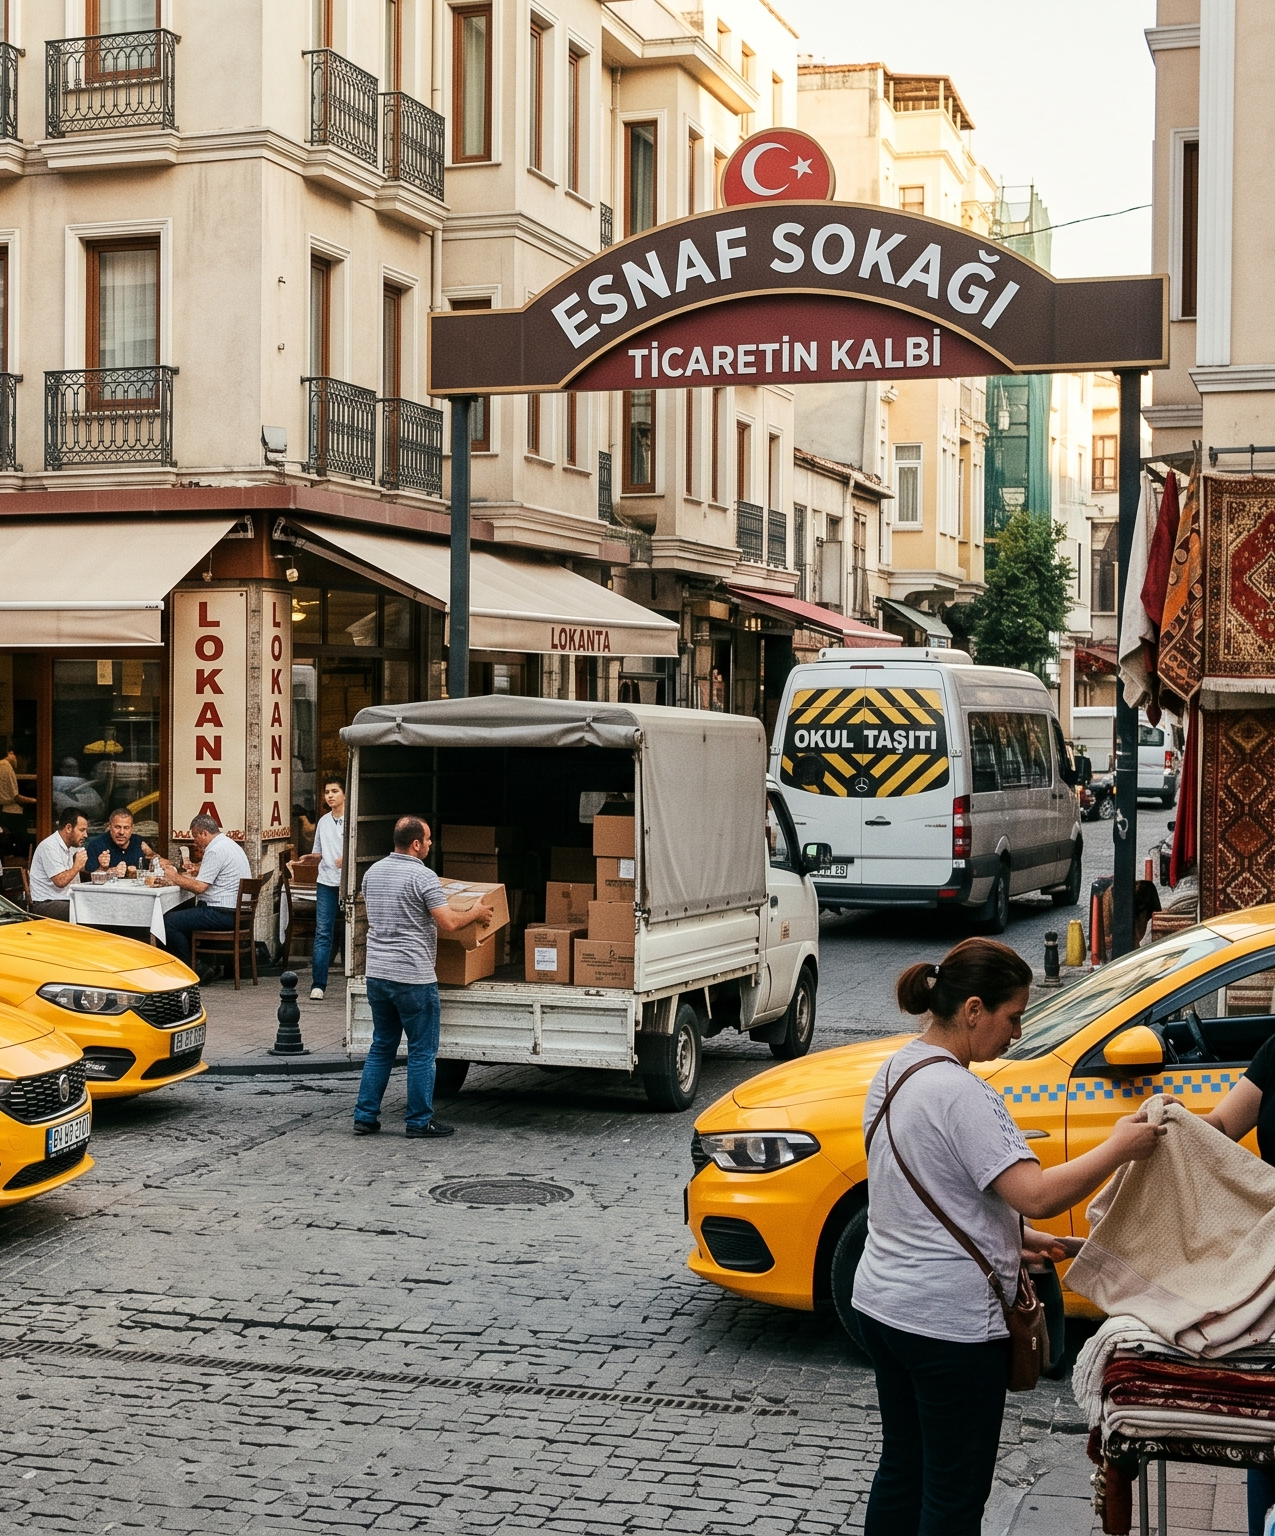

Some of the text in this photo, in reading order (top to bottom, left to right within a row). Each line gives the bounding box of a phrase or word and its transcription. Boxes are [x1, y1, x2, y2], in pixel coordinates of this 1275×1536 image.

[551, 222, 1021, 349] ESNAF SOKAĞI
[628, 329, 941, 379] TİCARETİN KALBİ
[550, 627, 612, 653] LOKANTA
[195, 601, 224, 828] LOKANTA
[270, 601, 282, 827] LOKANTA
[794, 729, 937, 754] OKUL TAŞITI
